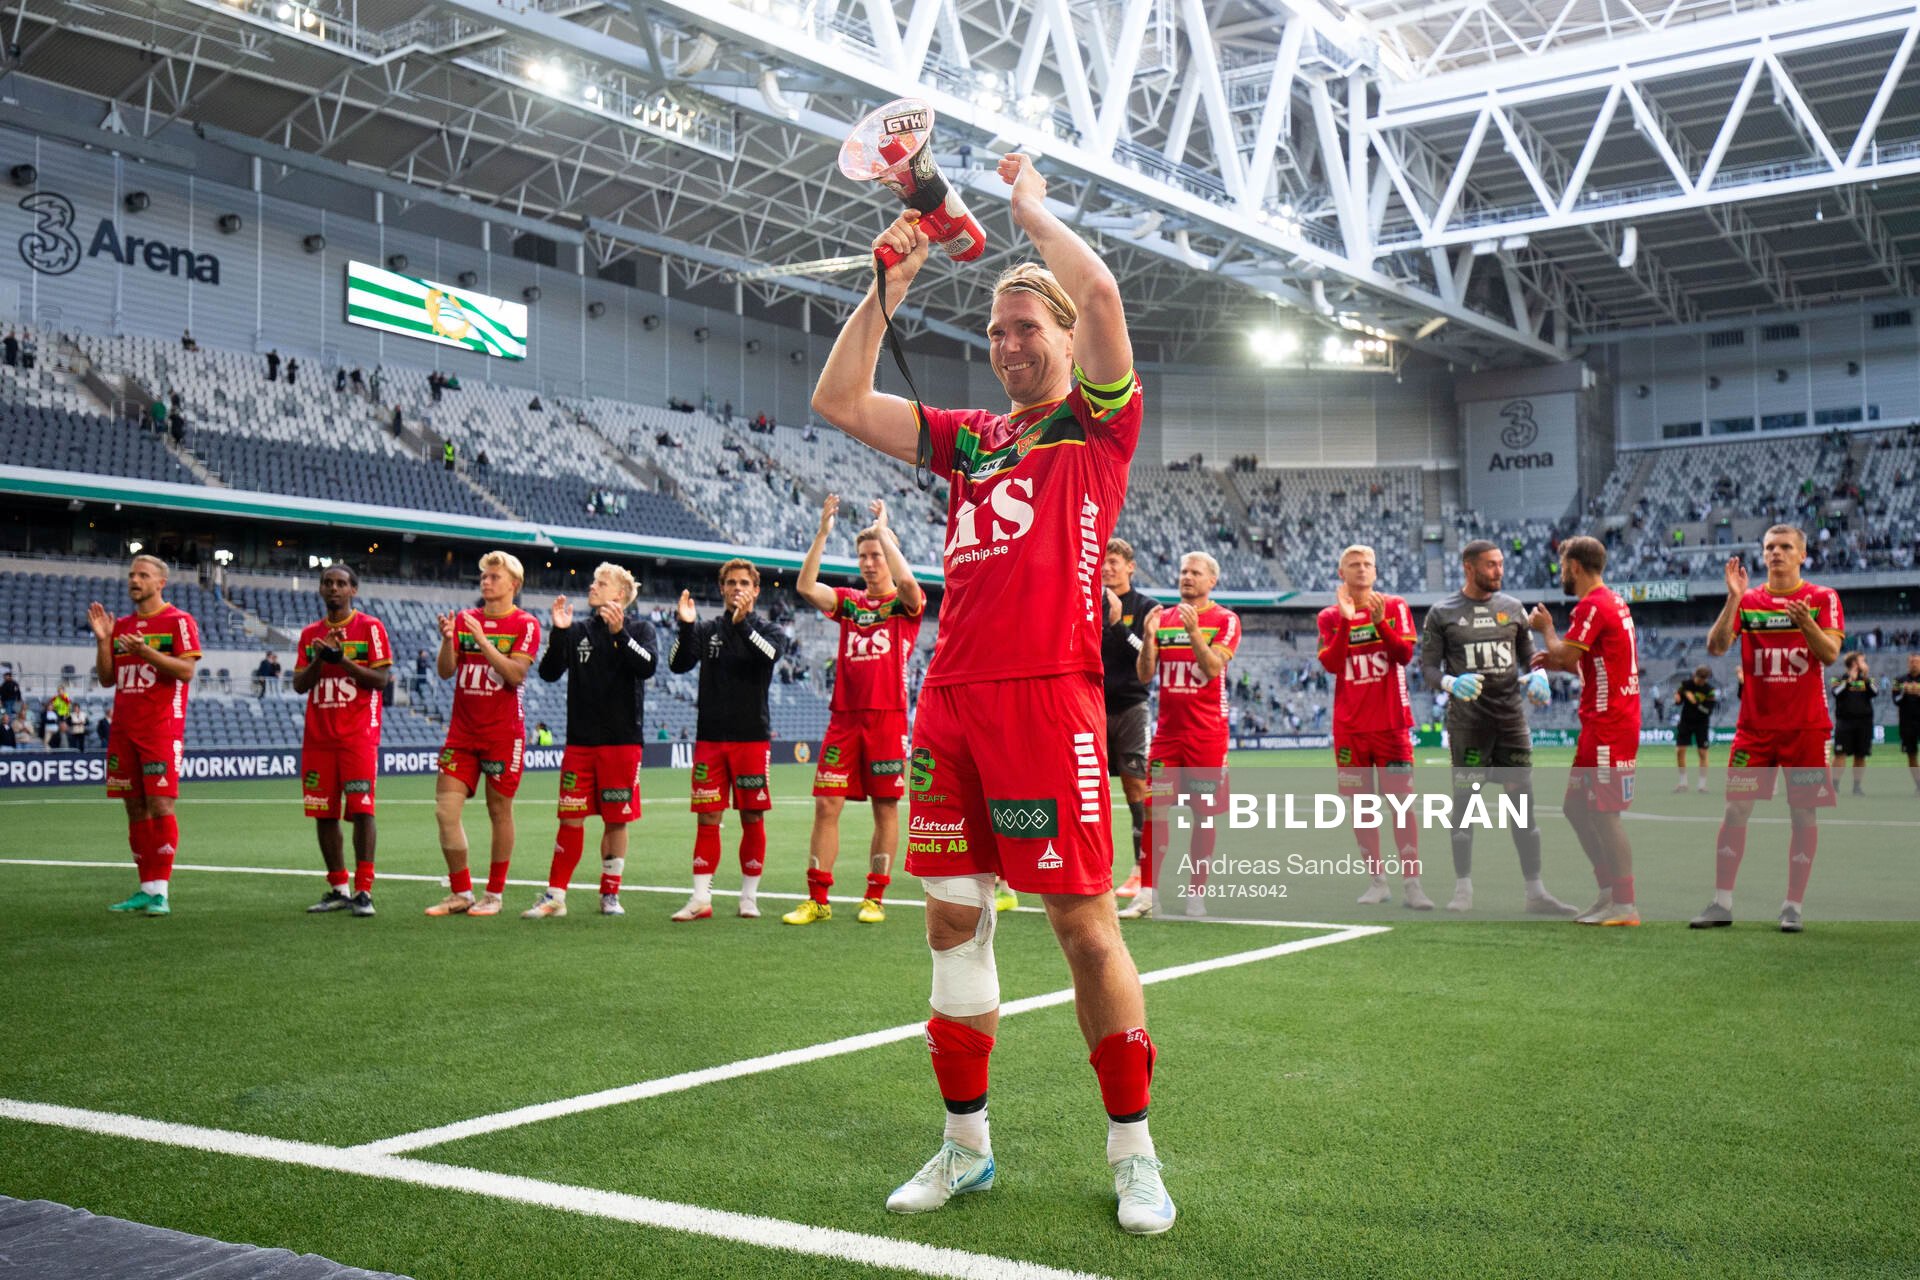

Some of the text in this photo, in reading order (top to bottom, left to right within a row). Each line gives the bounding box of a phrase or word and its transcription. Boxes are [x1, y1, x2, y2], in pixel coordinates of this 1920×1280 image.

[88, 218, 221, 285] Arena
[1488, 451, 1554, 472] Arena
[579, 650, 591, 663] 17
[1464, 641, 1512, 669] ITS
[1753, 647, 1809, 677] ITS
[459, 663, 505, 691] ITS
[1162, 661, 1208, 688] ITS
[178, 754, 297, 778] WORKWEAR
[910, 816, 965, 832] Ekstrand
[946, 839, 968, 853] AB
[1037, 860, 1064, 870] SELECT
